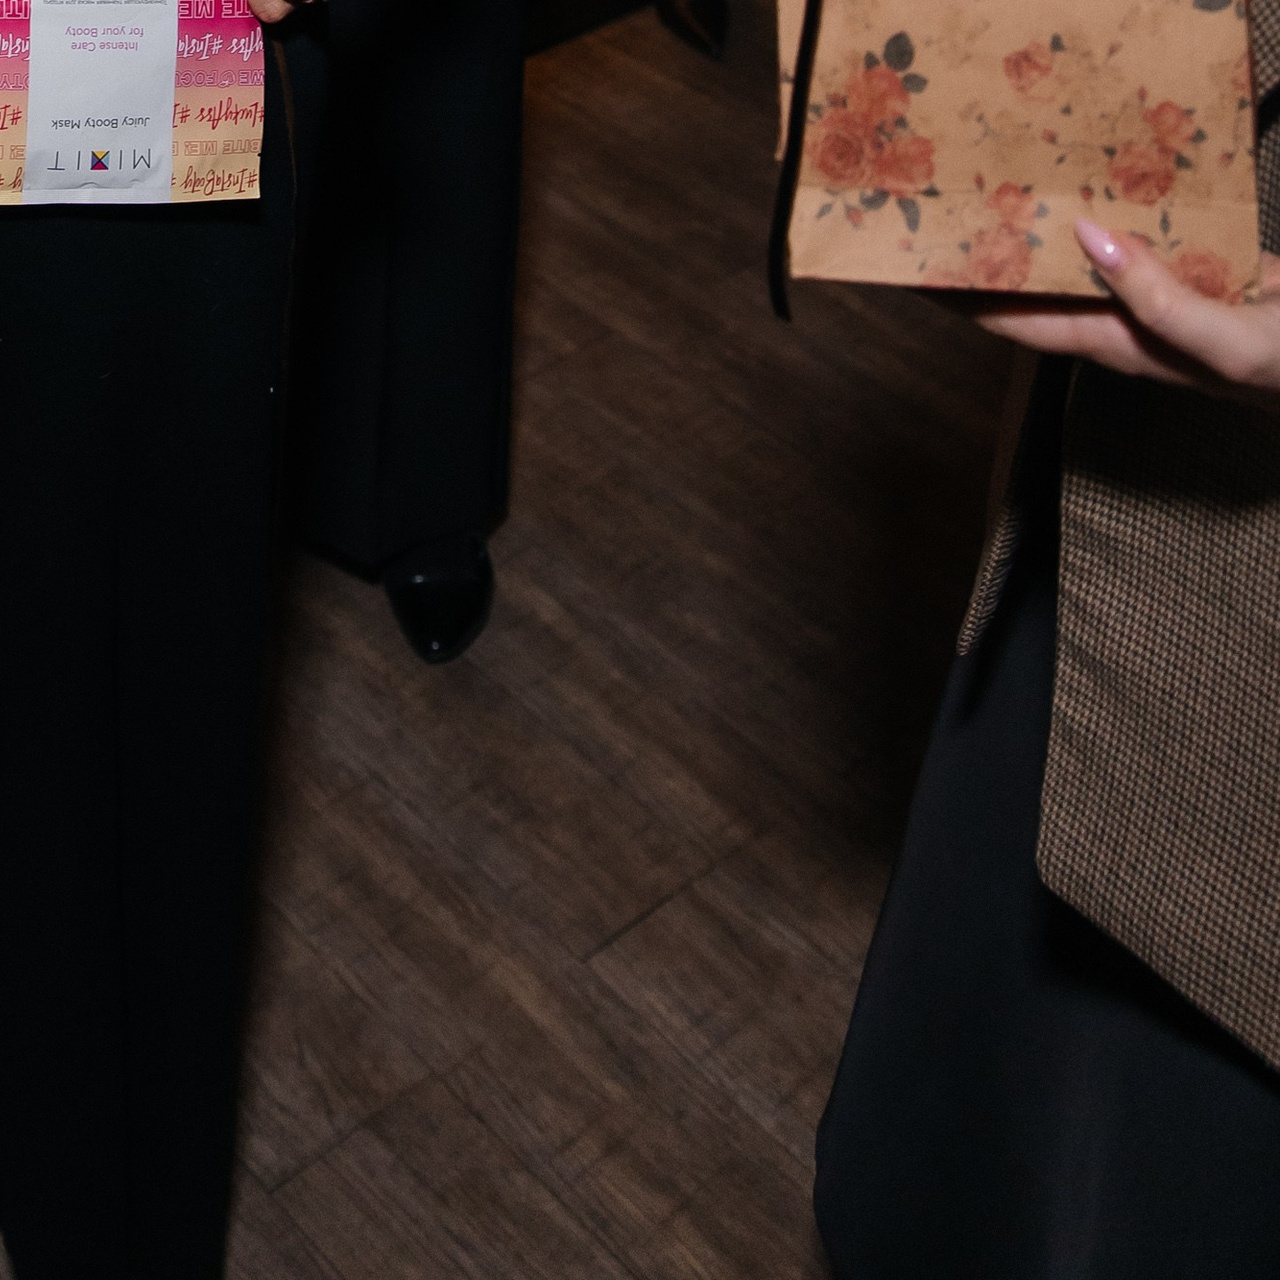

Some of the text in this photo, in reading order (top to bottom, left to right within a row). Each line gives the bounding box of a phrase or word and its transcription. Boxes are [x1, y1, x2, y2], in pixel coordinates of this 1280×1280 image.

[65, 26, 144, 37] for your Booty
[71, 42, 138, 51] Intense Care
[51, 116, 150, 130] Juicy Booty Mask
[184, 140, 217, 156] ME!
[222, 139, 260, 154] BITE
[47, 148, 151, 171] MIXIT
